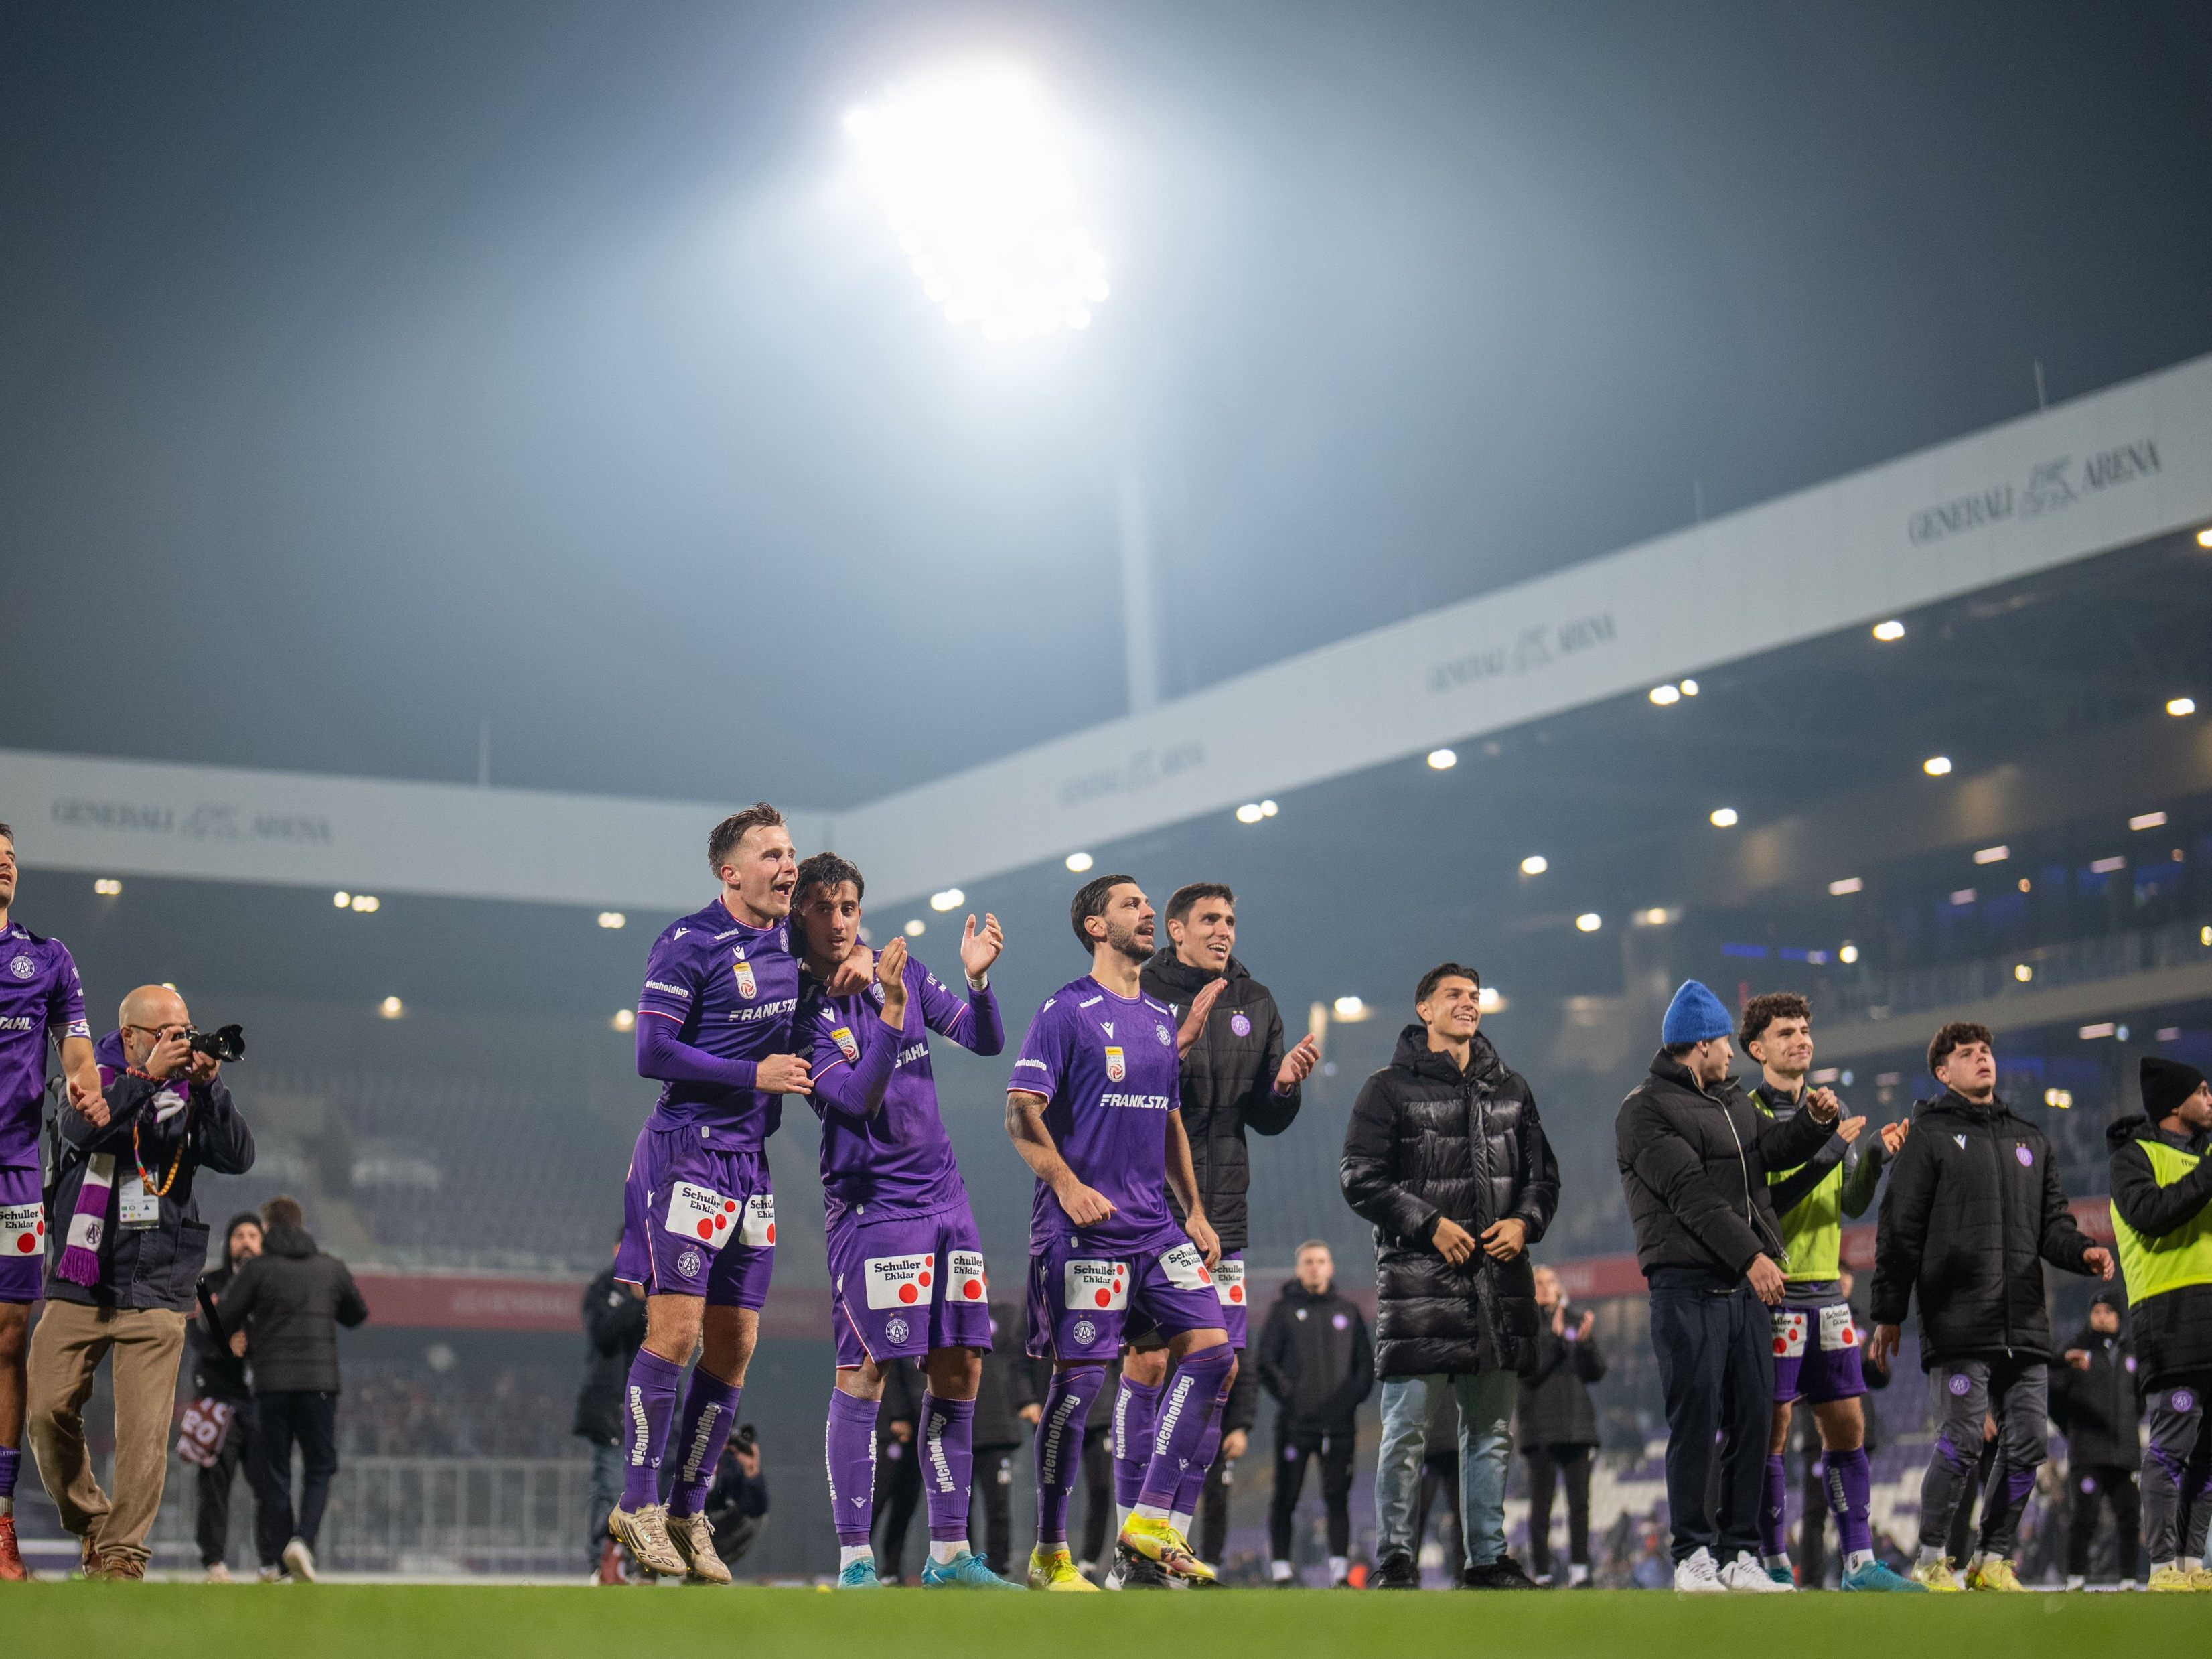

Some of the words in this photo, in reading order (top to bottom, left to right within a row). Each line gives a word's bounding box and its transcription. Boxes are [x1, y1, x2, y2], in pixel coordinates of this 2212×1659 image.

[874, 1260, 921, 1273] Schuller
[885, 1272, 914, 1281] Eh'klar
[1083, 1275, 1111, 1283] Eh'klar
